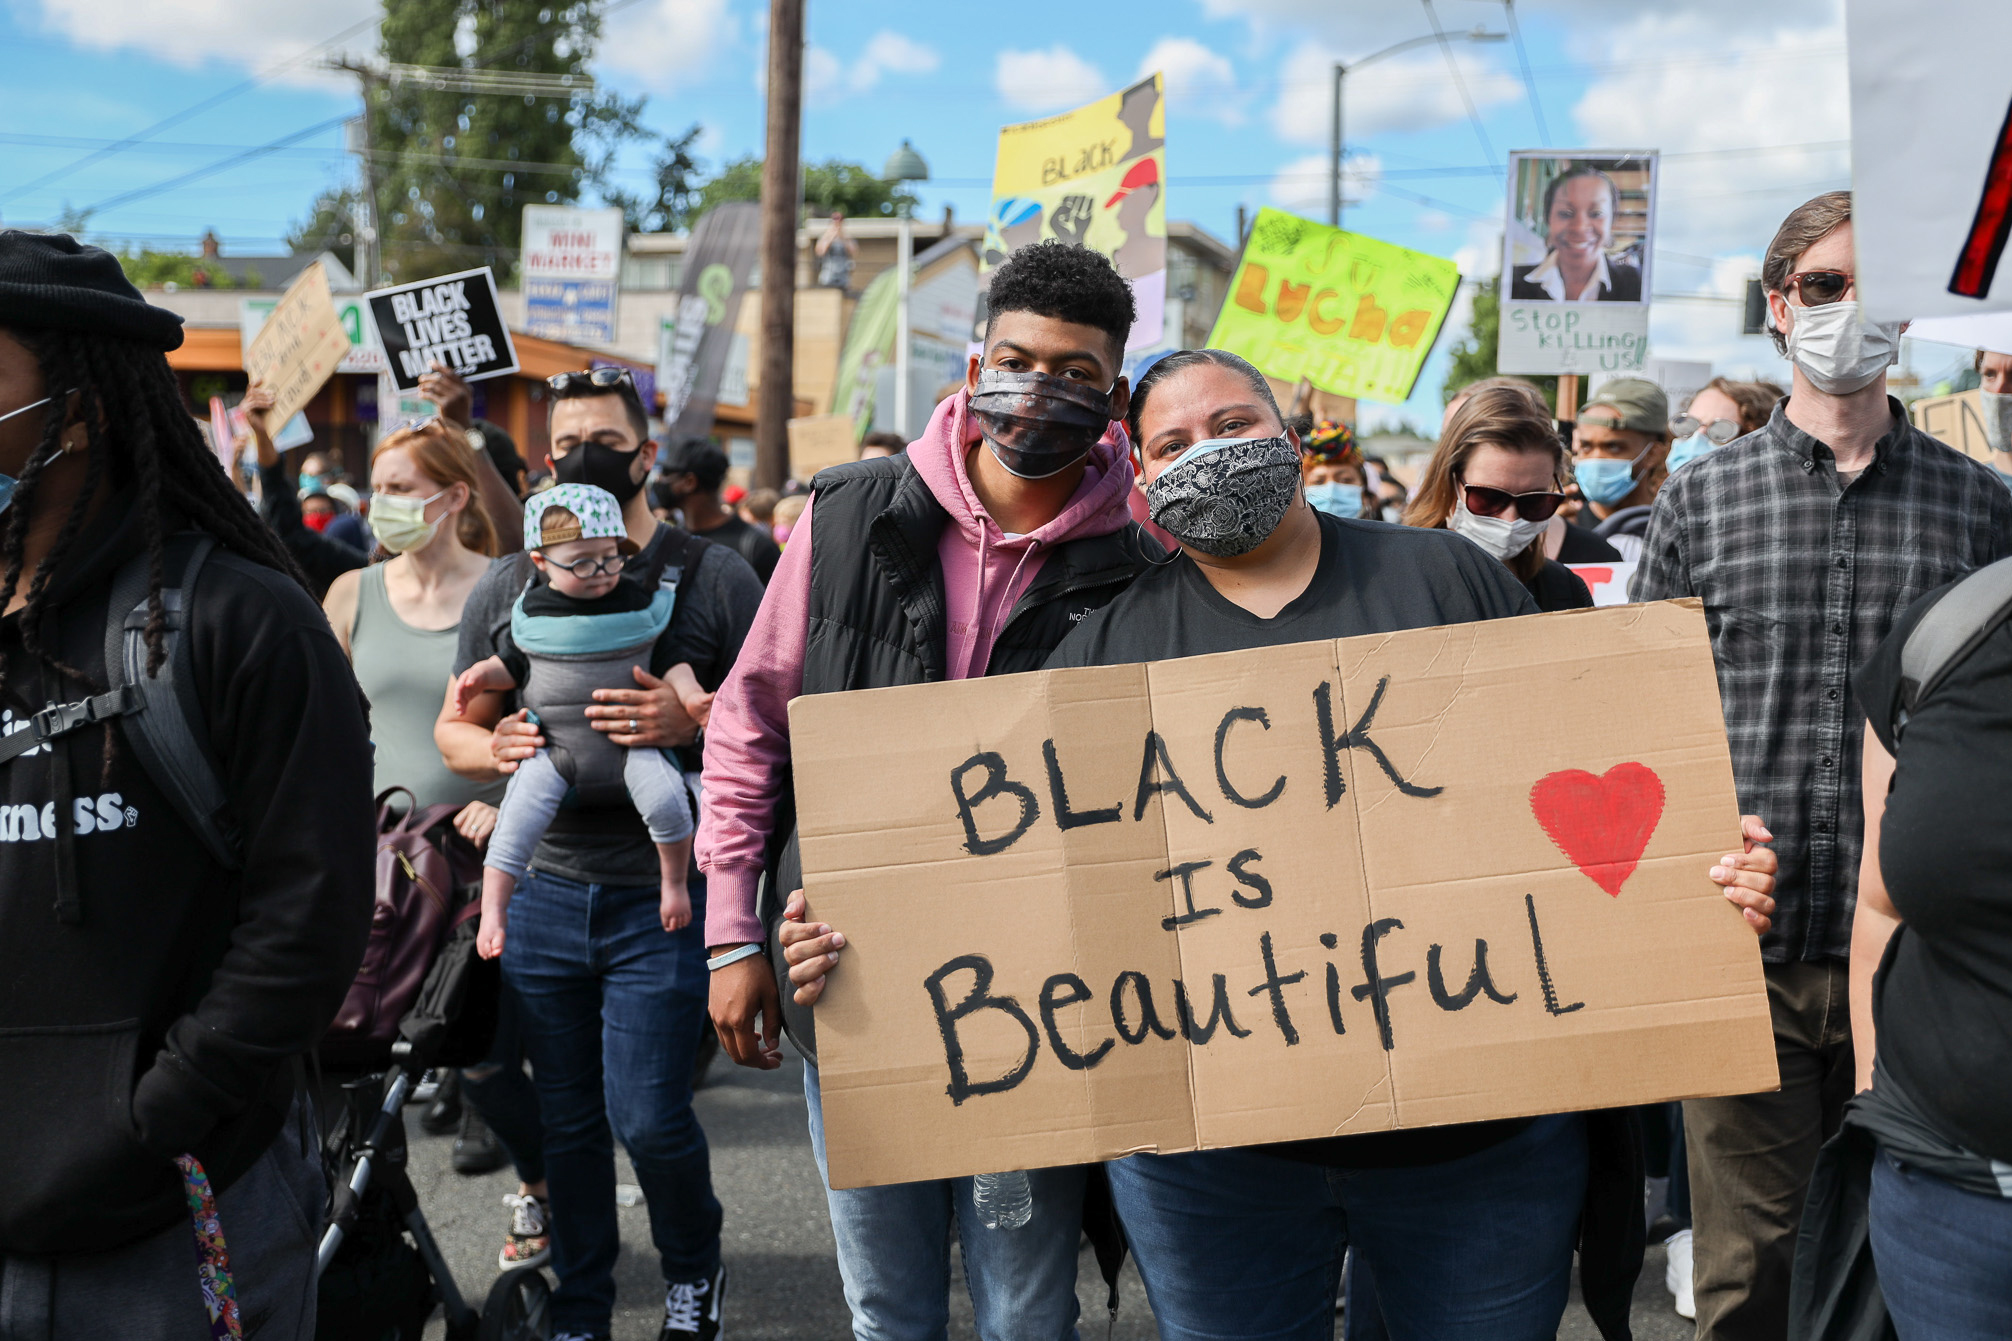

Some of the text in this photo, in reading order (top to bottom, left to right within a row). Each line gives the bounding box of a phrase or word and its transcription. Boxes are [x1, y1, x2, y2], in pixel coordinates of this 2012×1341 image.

[391, 281, 471, 324] BLACK
[403, 310, 472, 349] LIVES
[399, 334, 498, 379] MATTER
[1069, 612, 1088, 621] NOR
[950, 675, 1444, 856] BLACK
[0, 792, 124, 842] ness
